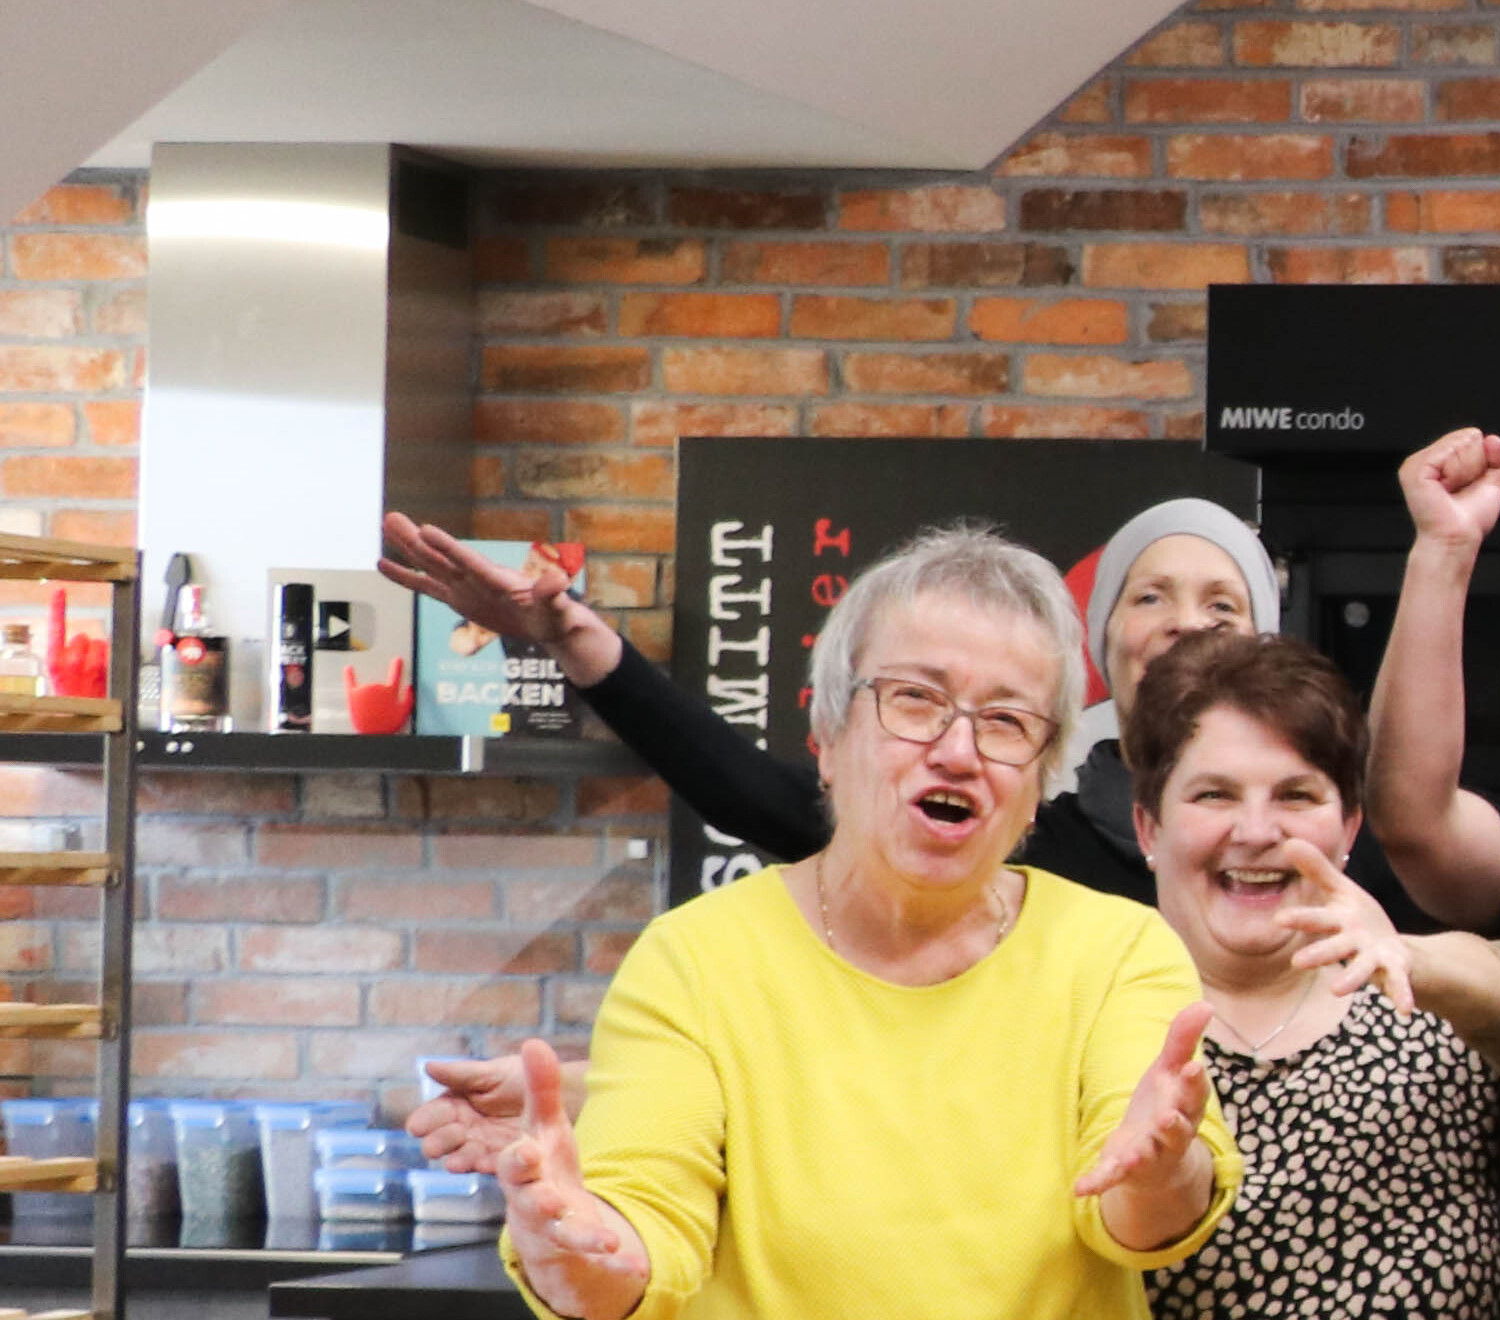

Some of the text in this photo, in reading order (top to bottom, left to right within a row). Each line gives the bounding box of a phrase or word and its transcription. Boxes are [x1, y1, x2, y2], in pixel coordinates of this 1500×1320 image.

[1220, 406, 1365, 430] MIWE condo
[503, 657, 565, 679] GEIL
[436, 681, 565, 706] BACKEN
[701, 520, 774, 895] SMITT
